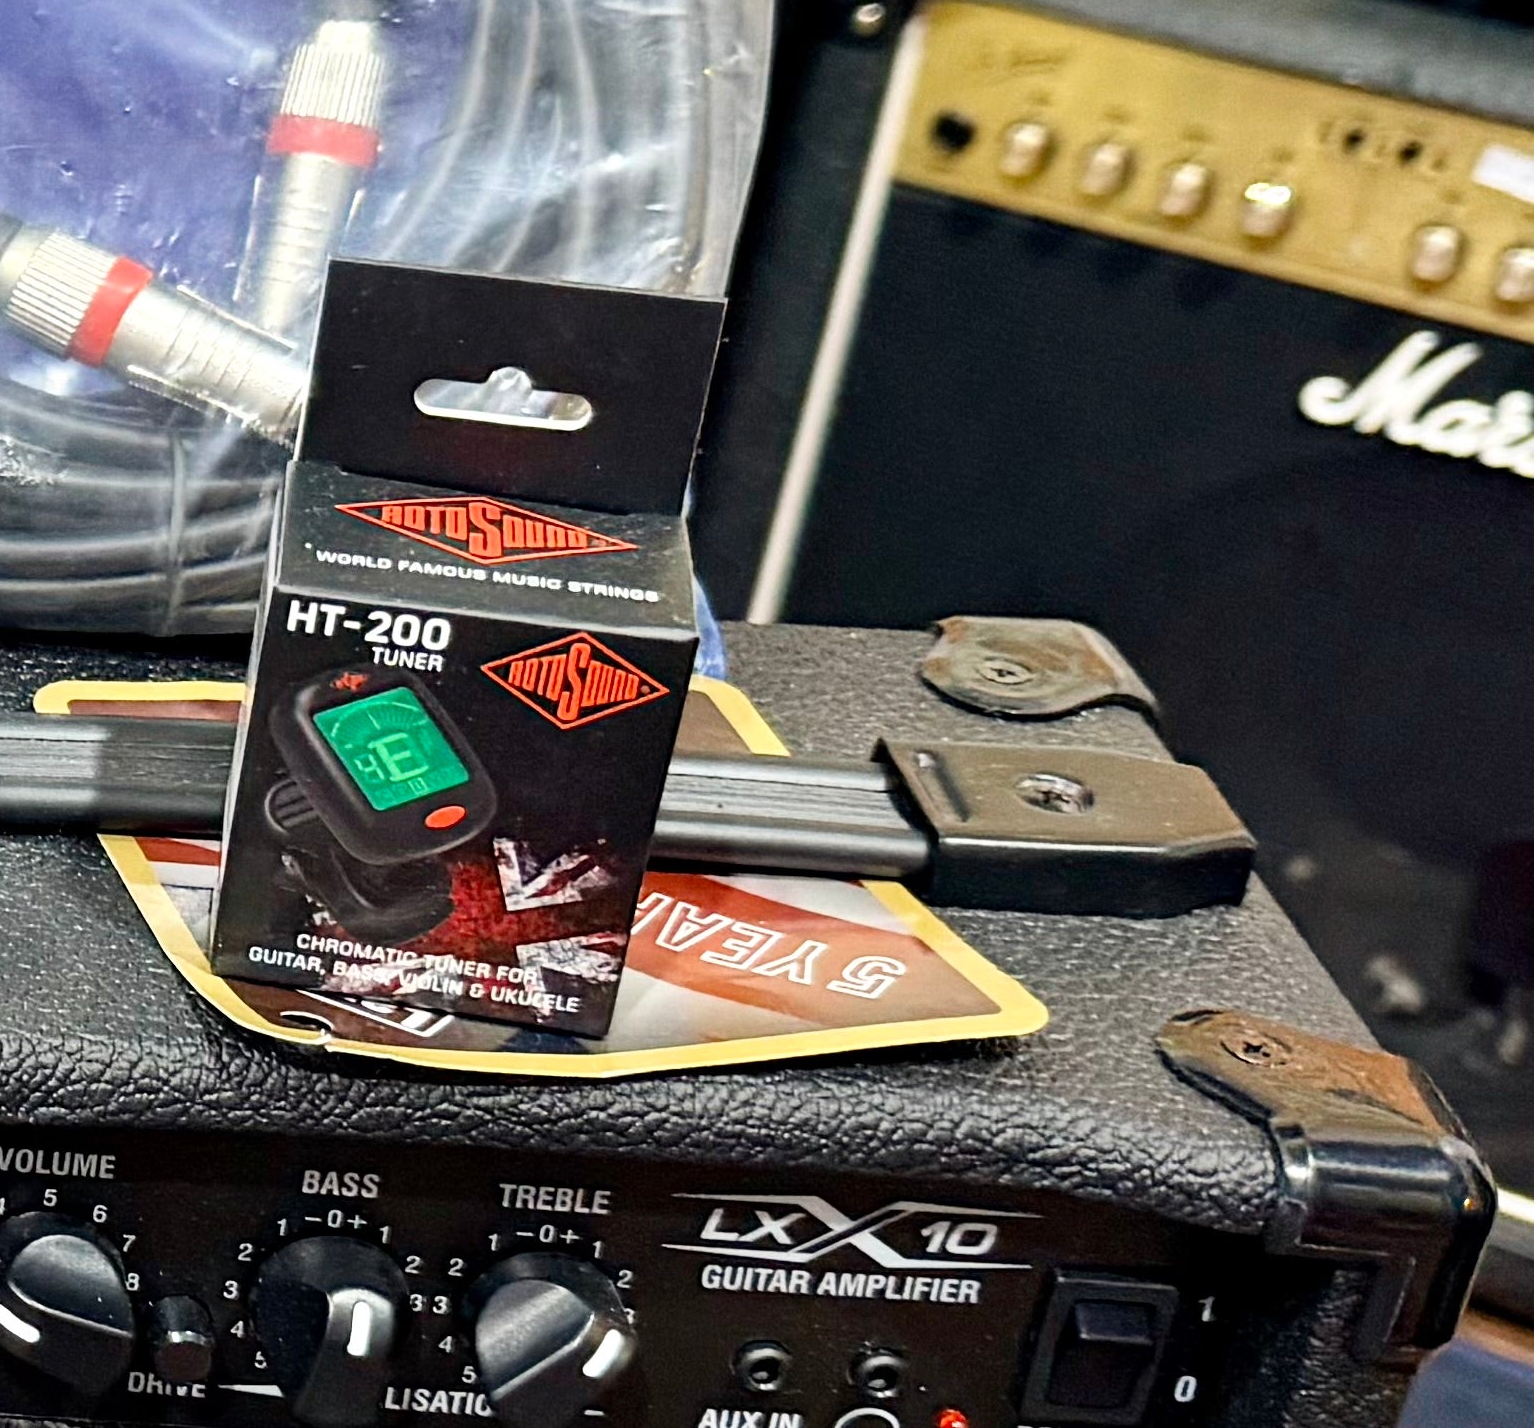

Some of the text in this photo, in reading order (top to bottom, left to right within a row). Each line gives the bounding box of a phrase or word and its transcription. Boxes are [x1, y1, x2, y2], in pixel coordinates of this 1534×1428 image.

[1298, 328, 1534, 480] Mar
[315, 548, 661, 604] WORLD FAMOUS MUSIC STRINGS
[286, 599, 452, 652] HT-200
[371, 646, 445, 673] TUNER
[296, 933, 540, 987] CHROMATIC TUNER FOR
[248, 945, 326, 976] GUITAR,
[396, 968, 464, 997] VIOLIN
[489, 984, 581, 1014] UKULELE
[301, 1169, 382, 1200] BASS
[43, 1187, 59, 1208] 5
[499, 1183, 613, 1215] TREBLE
[92, 1204, 109, 1224] 6
[276, 1217, 289, 1237] 1
[379, 1224, 392, 1245] 1
[122, 1233, 137, 1254] 7
[237, 1242, 254, 1263] 2
[487, 1232, 501, 1252] 1
[592, 1239, 605, 1260] 1
[404, 1254, 423, 1275] 2
[447, 1257, 466, 1278] 2
[126, 1272, 141, 1292] 8
[222, 1279, 240, 1300] 3
[616, 1269, 634, 1290] 2
[701, 1264, 982, 1305] GUITAR AMPLIFIER
[409, 1293, 424, 1313] 3
[431, 1294, 451, 1316] 3
[229, 1320, 246, 1340] 4
[437, 1334, 455, 1354] 4
[461, 1364, 479, 1385] 5
